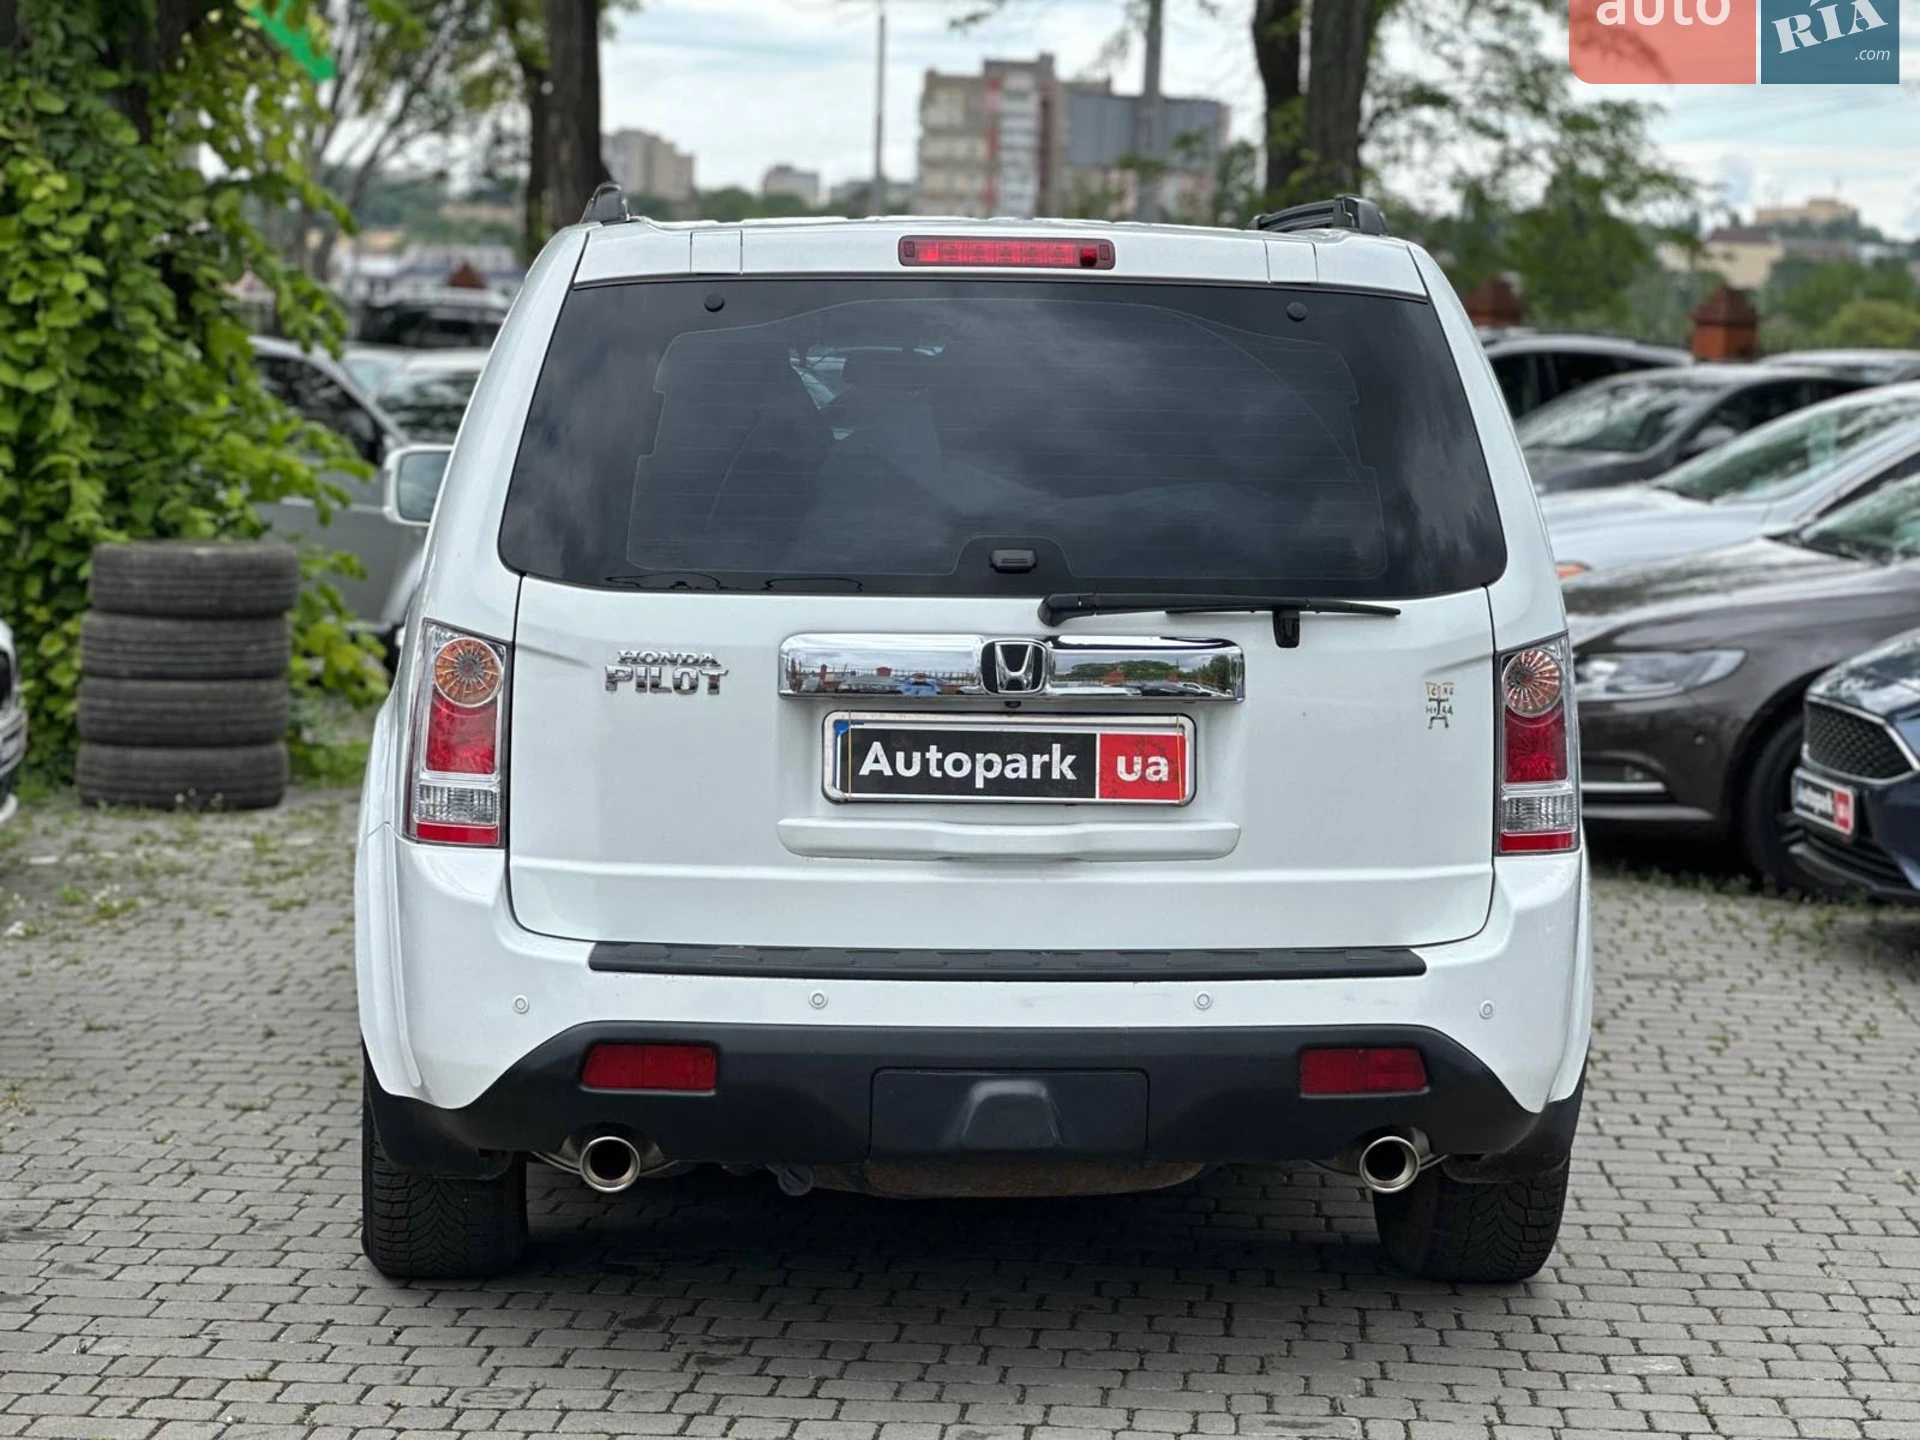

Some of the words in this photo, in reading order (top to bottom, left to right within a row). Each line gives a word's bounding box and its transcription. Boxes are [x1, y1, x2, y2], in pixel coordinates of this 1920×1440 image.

[617, 649, 722, 667] HONDA
[605, 665, 729, 695] PILOT
[858, 741, 1077, 789] Autopark
[1116, 755, 1169, 782] ua
